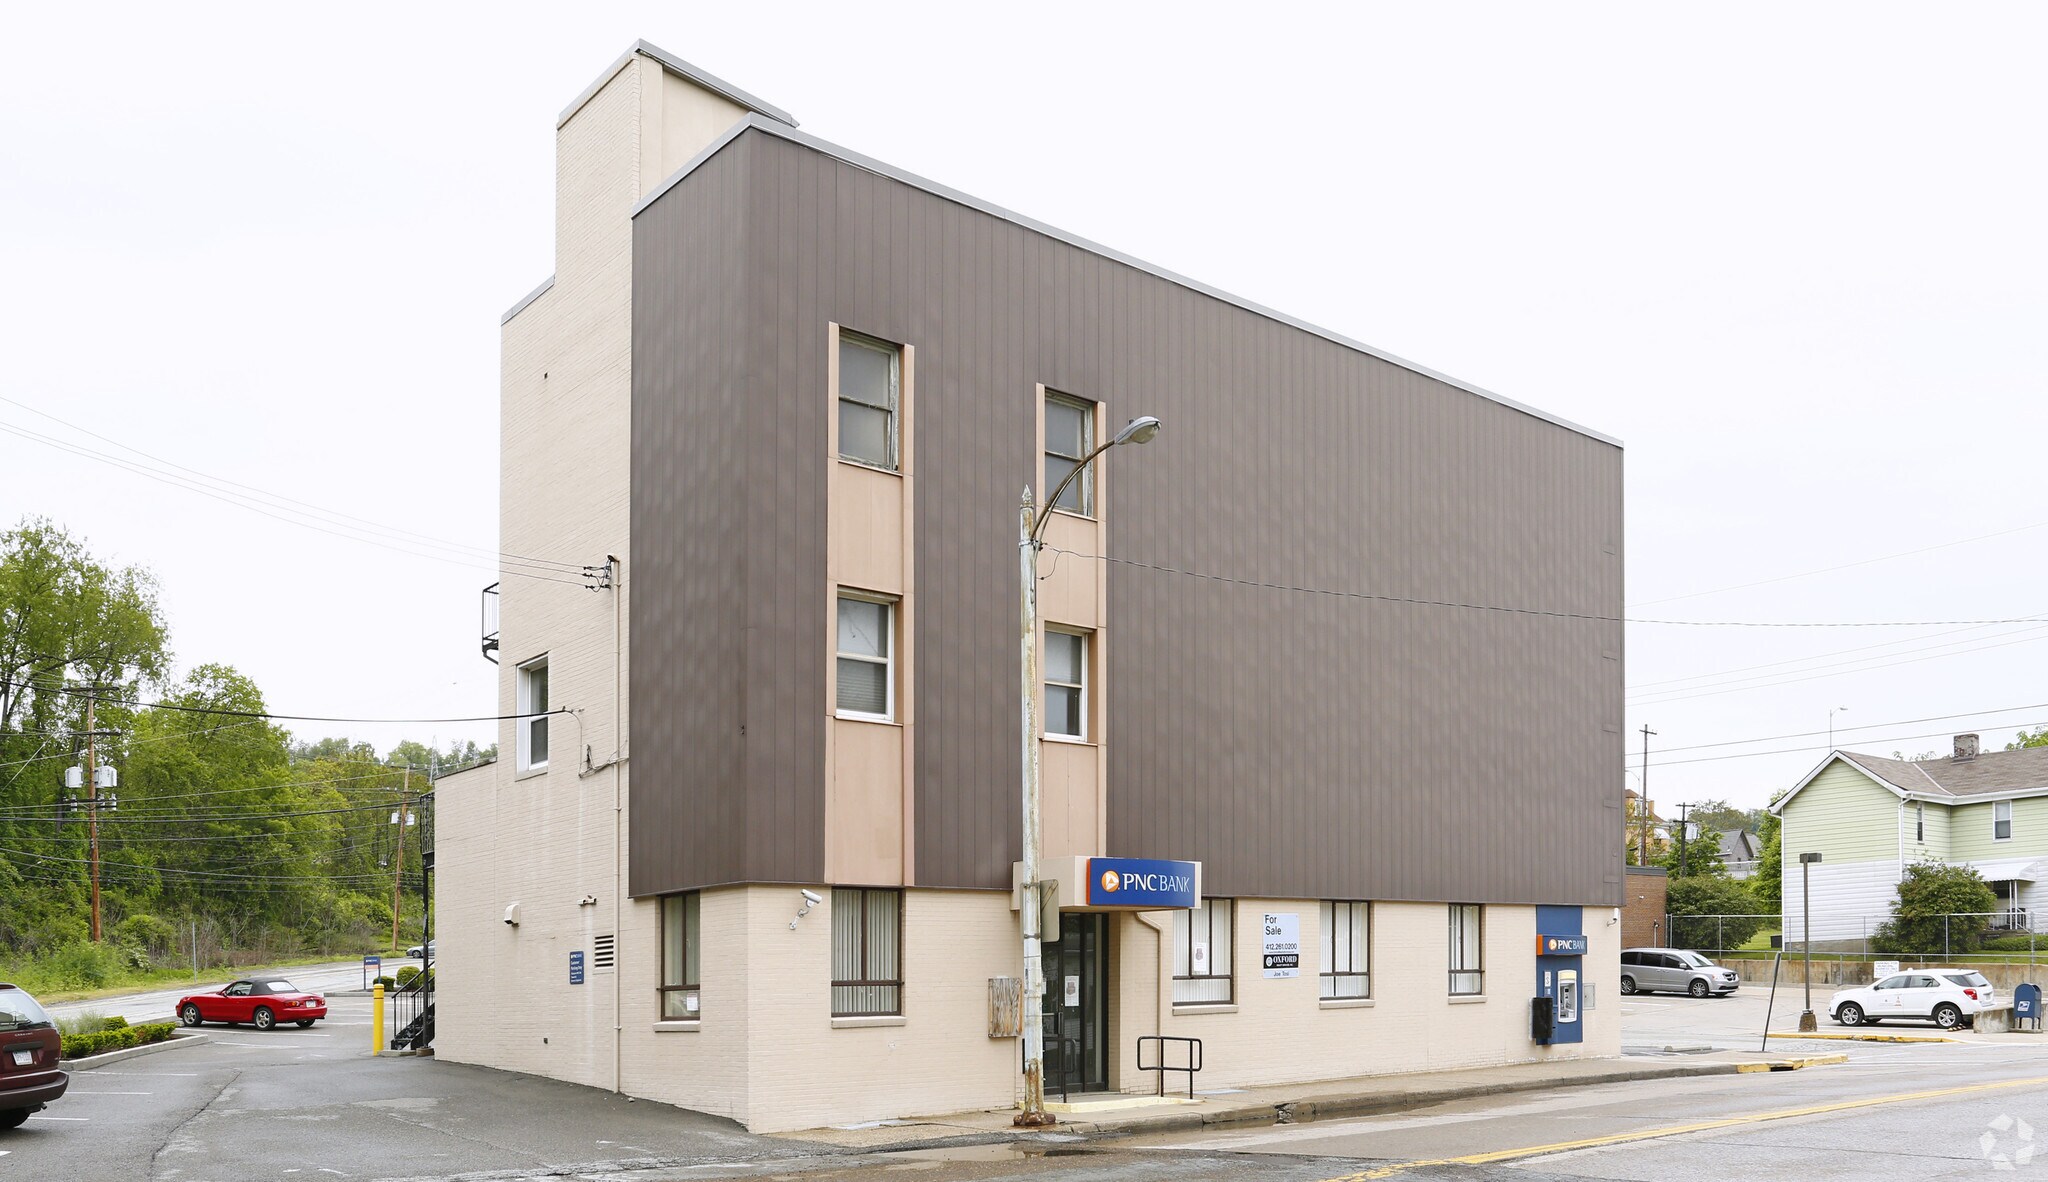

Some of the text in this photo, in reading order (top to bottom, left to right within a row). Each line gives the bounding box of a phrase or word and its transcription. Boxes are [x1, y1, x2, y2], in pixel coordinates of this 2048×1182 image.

[1122, 873, 1190, 892] PNC BANK
[1265, 915, 1277, 924] For
[1265, 926, 1281, 935] Sale
[1557, 940, 1585, 950] PNC BANK
